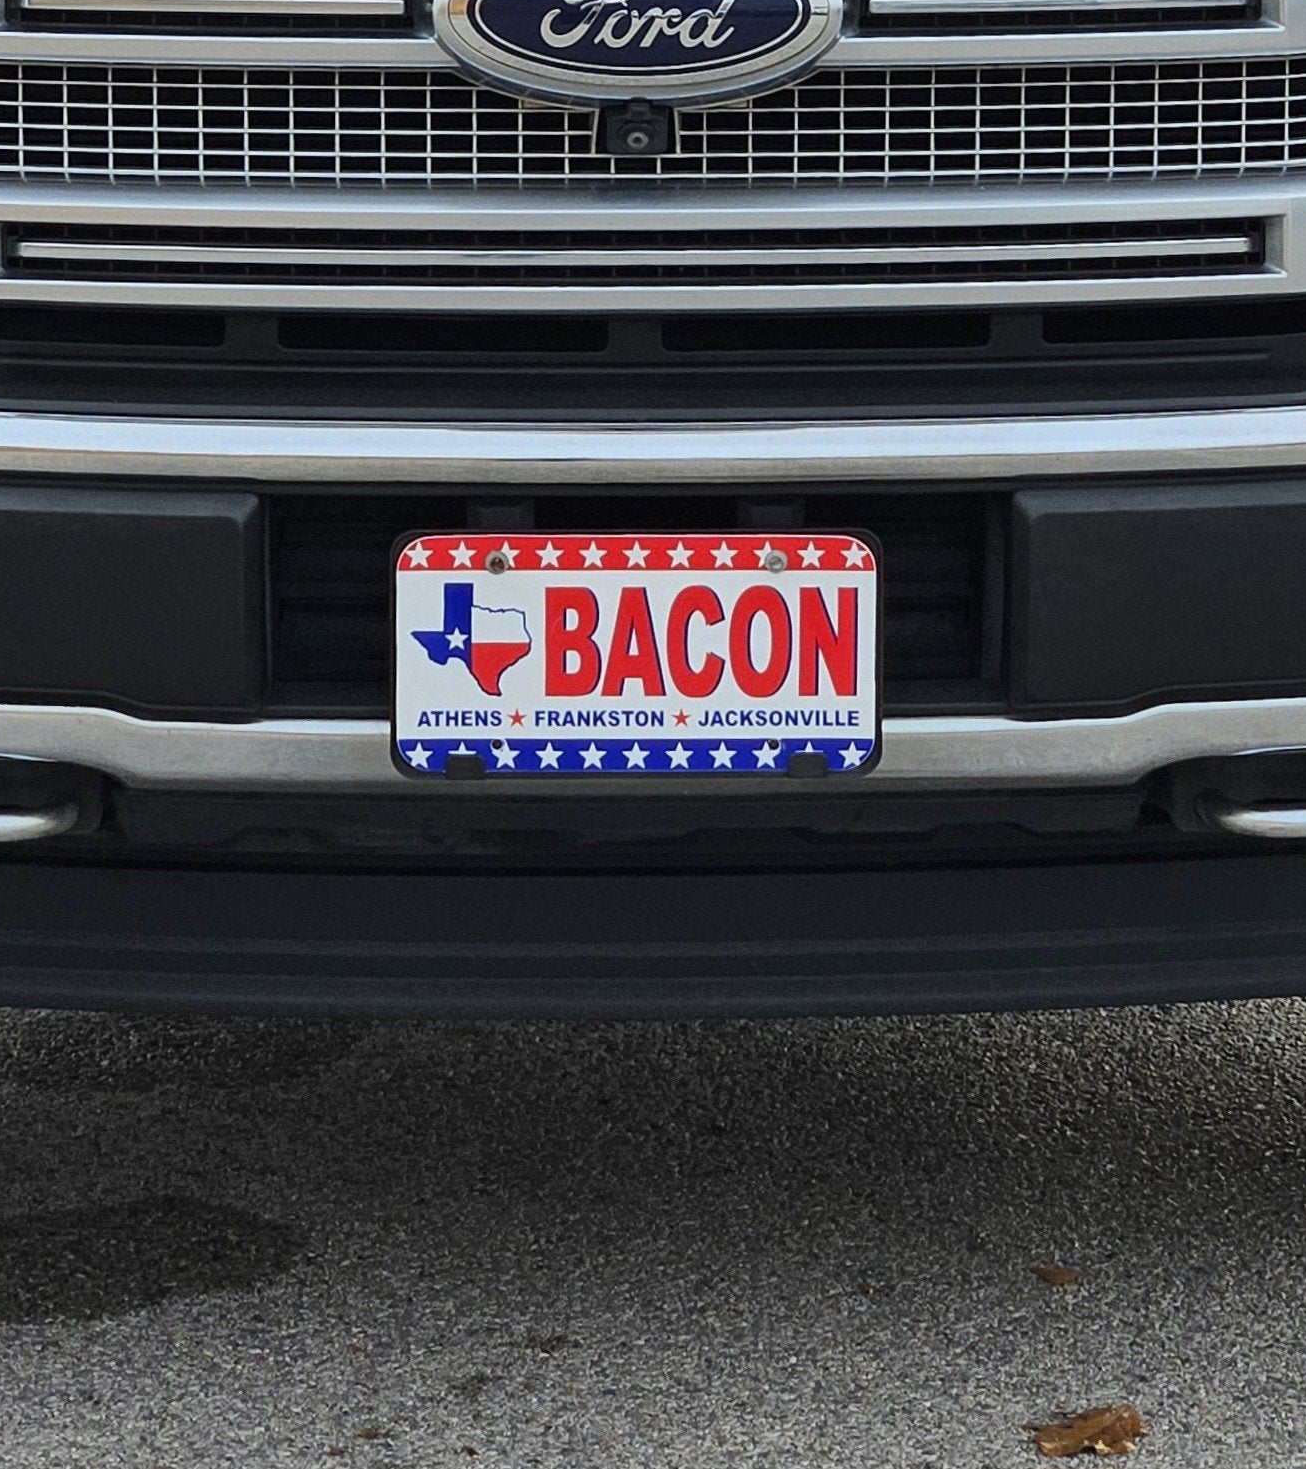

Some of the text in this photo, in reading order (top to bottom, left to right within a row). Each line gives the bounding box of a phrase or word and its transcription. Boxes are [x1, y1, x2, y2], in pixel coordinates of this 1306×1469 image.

[544, 585, 858, 697] BACON
[417, 709, 860, 728] ATHENS FRANKSTON JACKSONVILLE
